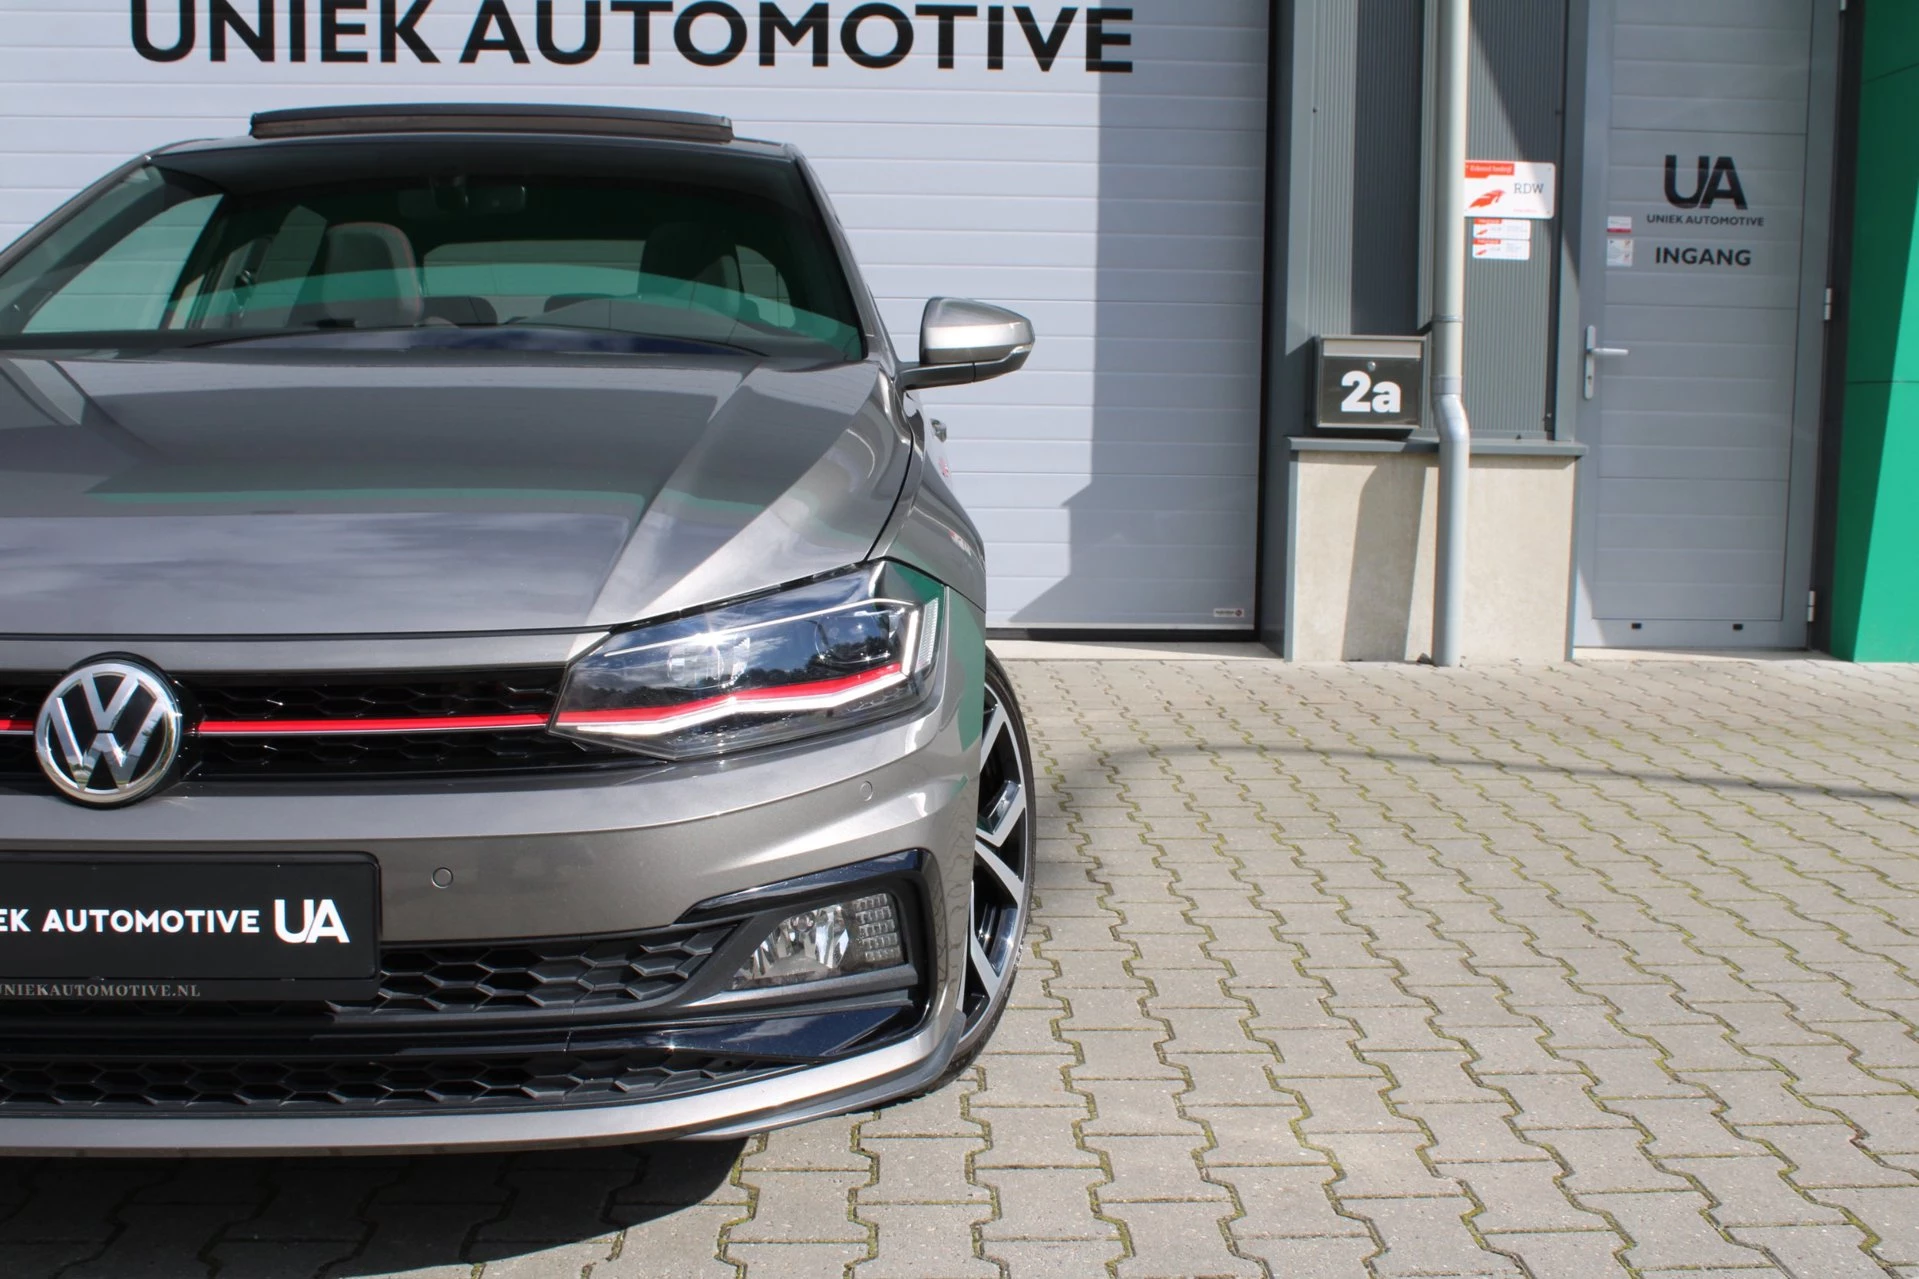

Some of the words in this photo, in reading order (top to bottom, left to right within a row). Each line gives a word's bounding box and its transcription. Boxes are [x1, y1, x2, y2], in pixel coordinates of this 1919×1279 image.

[131, 0, 441, 63] UNIEK
[459, 0, 1133, 73] AUTOMOTIVE
[1513, 182, 1544, 194] RDW
[1664, 155, 1748, 210] UA
[1646, 214, 1683, 224] UNIEK
[1685, 215, 1765, 227] AUTOMOTIVE
[1655, 247, 1752, 266] INGANG
[1341, 370, 1401, 413] 2a
[42, 909, 260, 933] AUTOMOTIVE
[274, 899, 350, 943] UA
[0, 983, 201, 997] NIEKAUTOMOTIVE.NL
